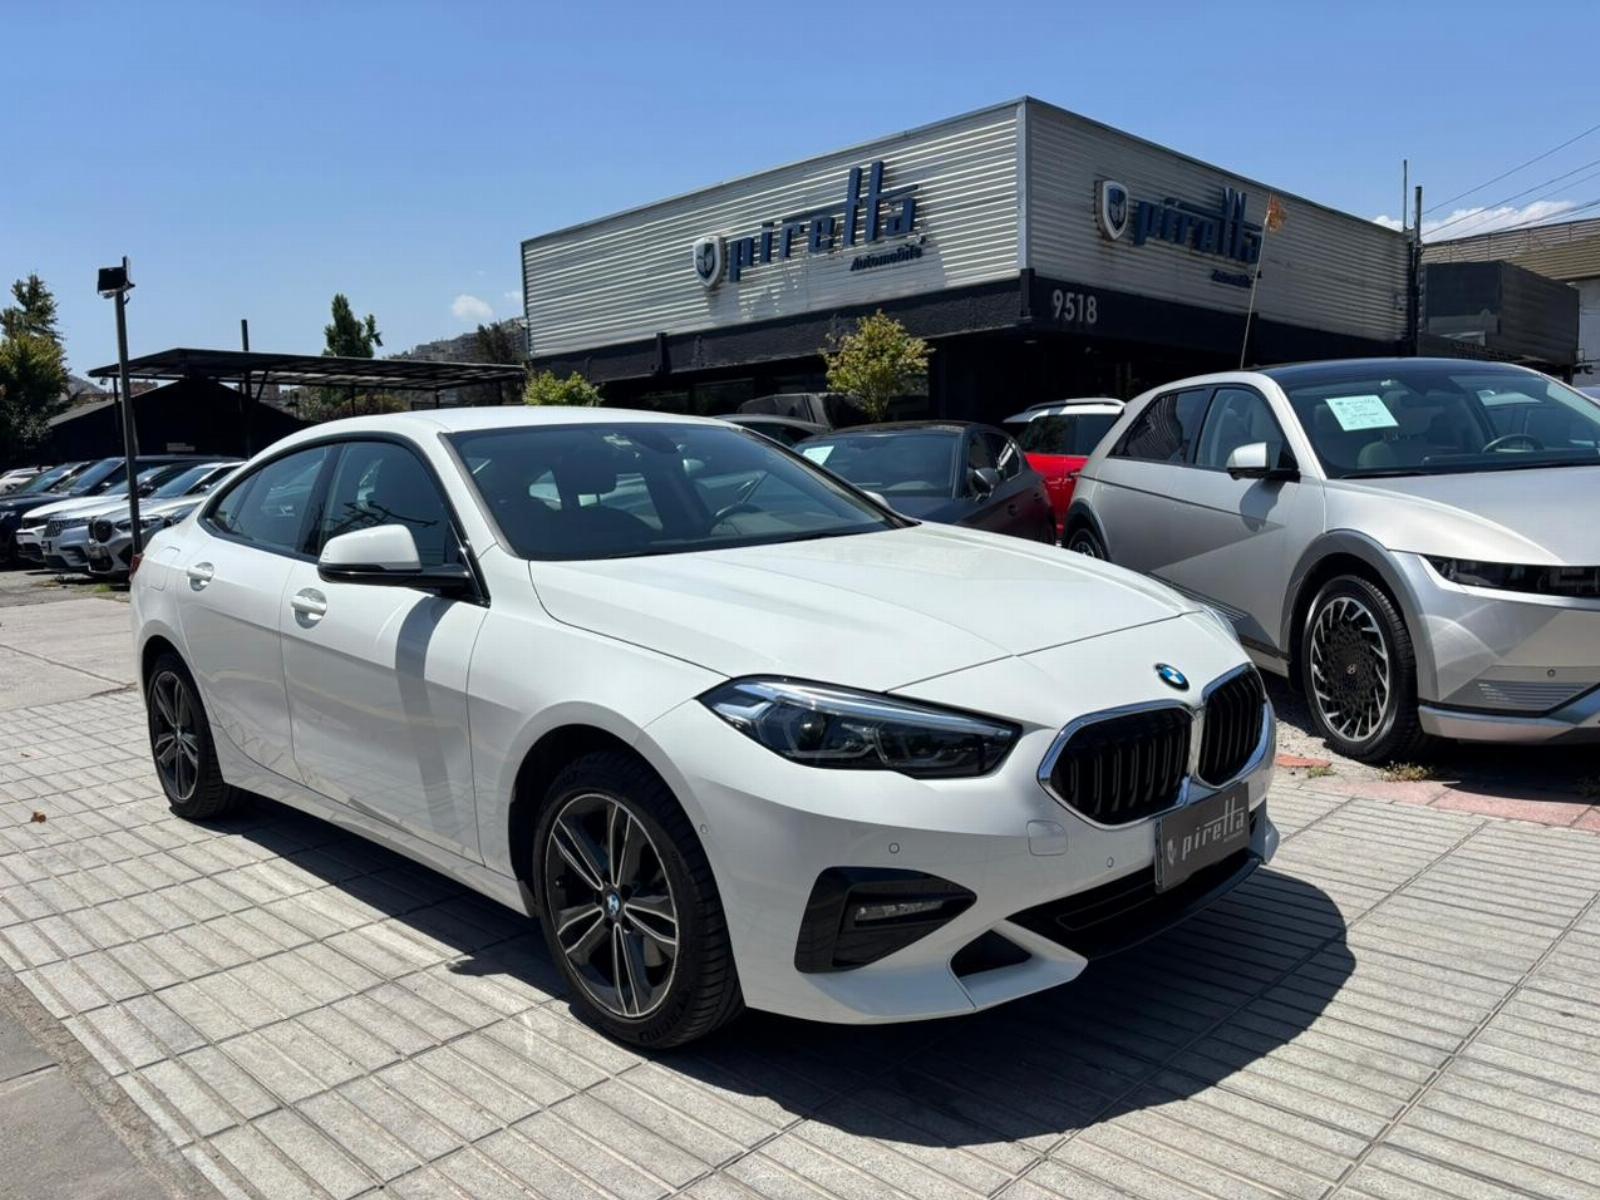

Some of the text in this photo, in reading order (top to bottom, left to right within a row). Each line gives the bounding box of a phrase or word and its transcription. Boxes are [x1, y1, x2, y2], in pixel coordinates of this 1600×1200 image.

[728, 160, 919, 283] piretta
[1052, 289, 1098, 324] 9518
[1182, 796, 1246, 861] piretta
